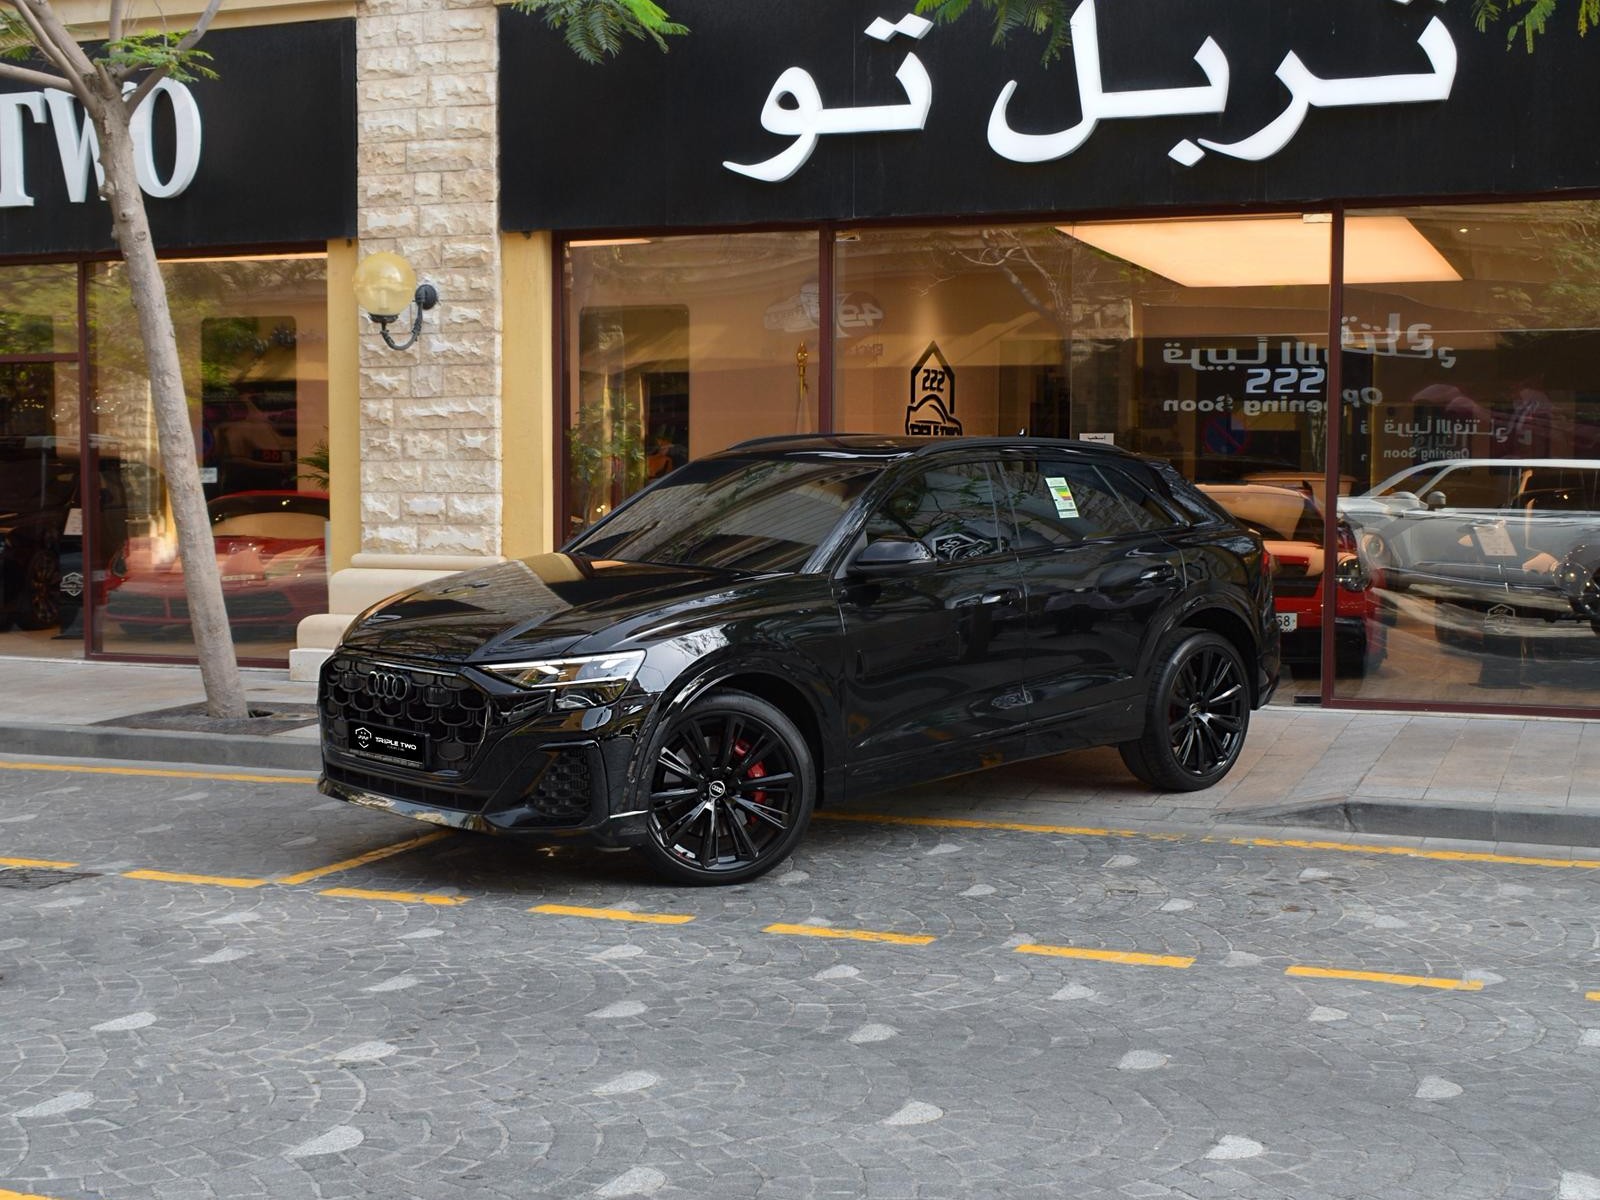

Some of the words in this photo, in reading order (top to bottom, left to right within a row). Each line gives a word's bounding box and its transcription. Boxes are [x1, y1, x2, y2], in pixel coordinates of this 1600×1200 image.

[722, 12, 934, 182] تو
[921, 369, 945, 392] 222
[375, 736, 399, 747] TRIPLE
[400, 741, 417, 751] TWO
